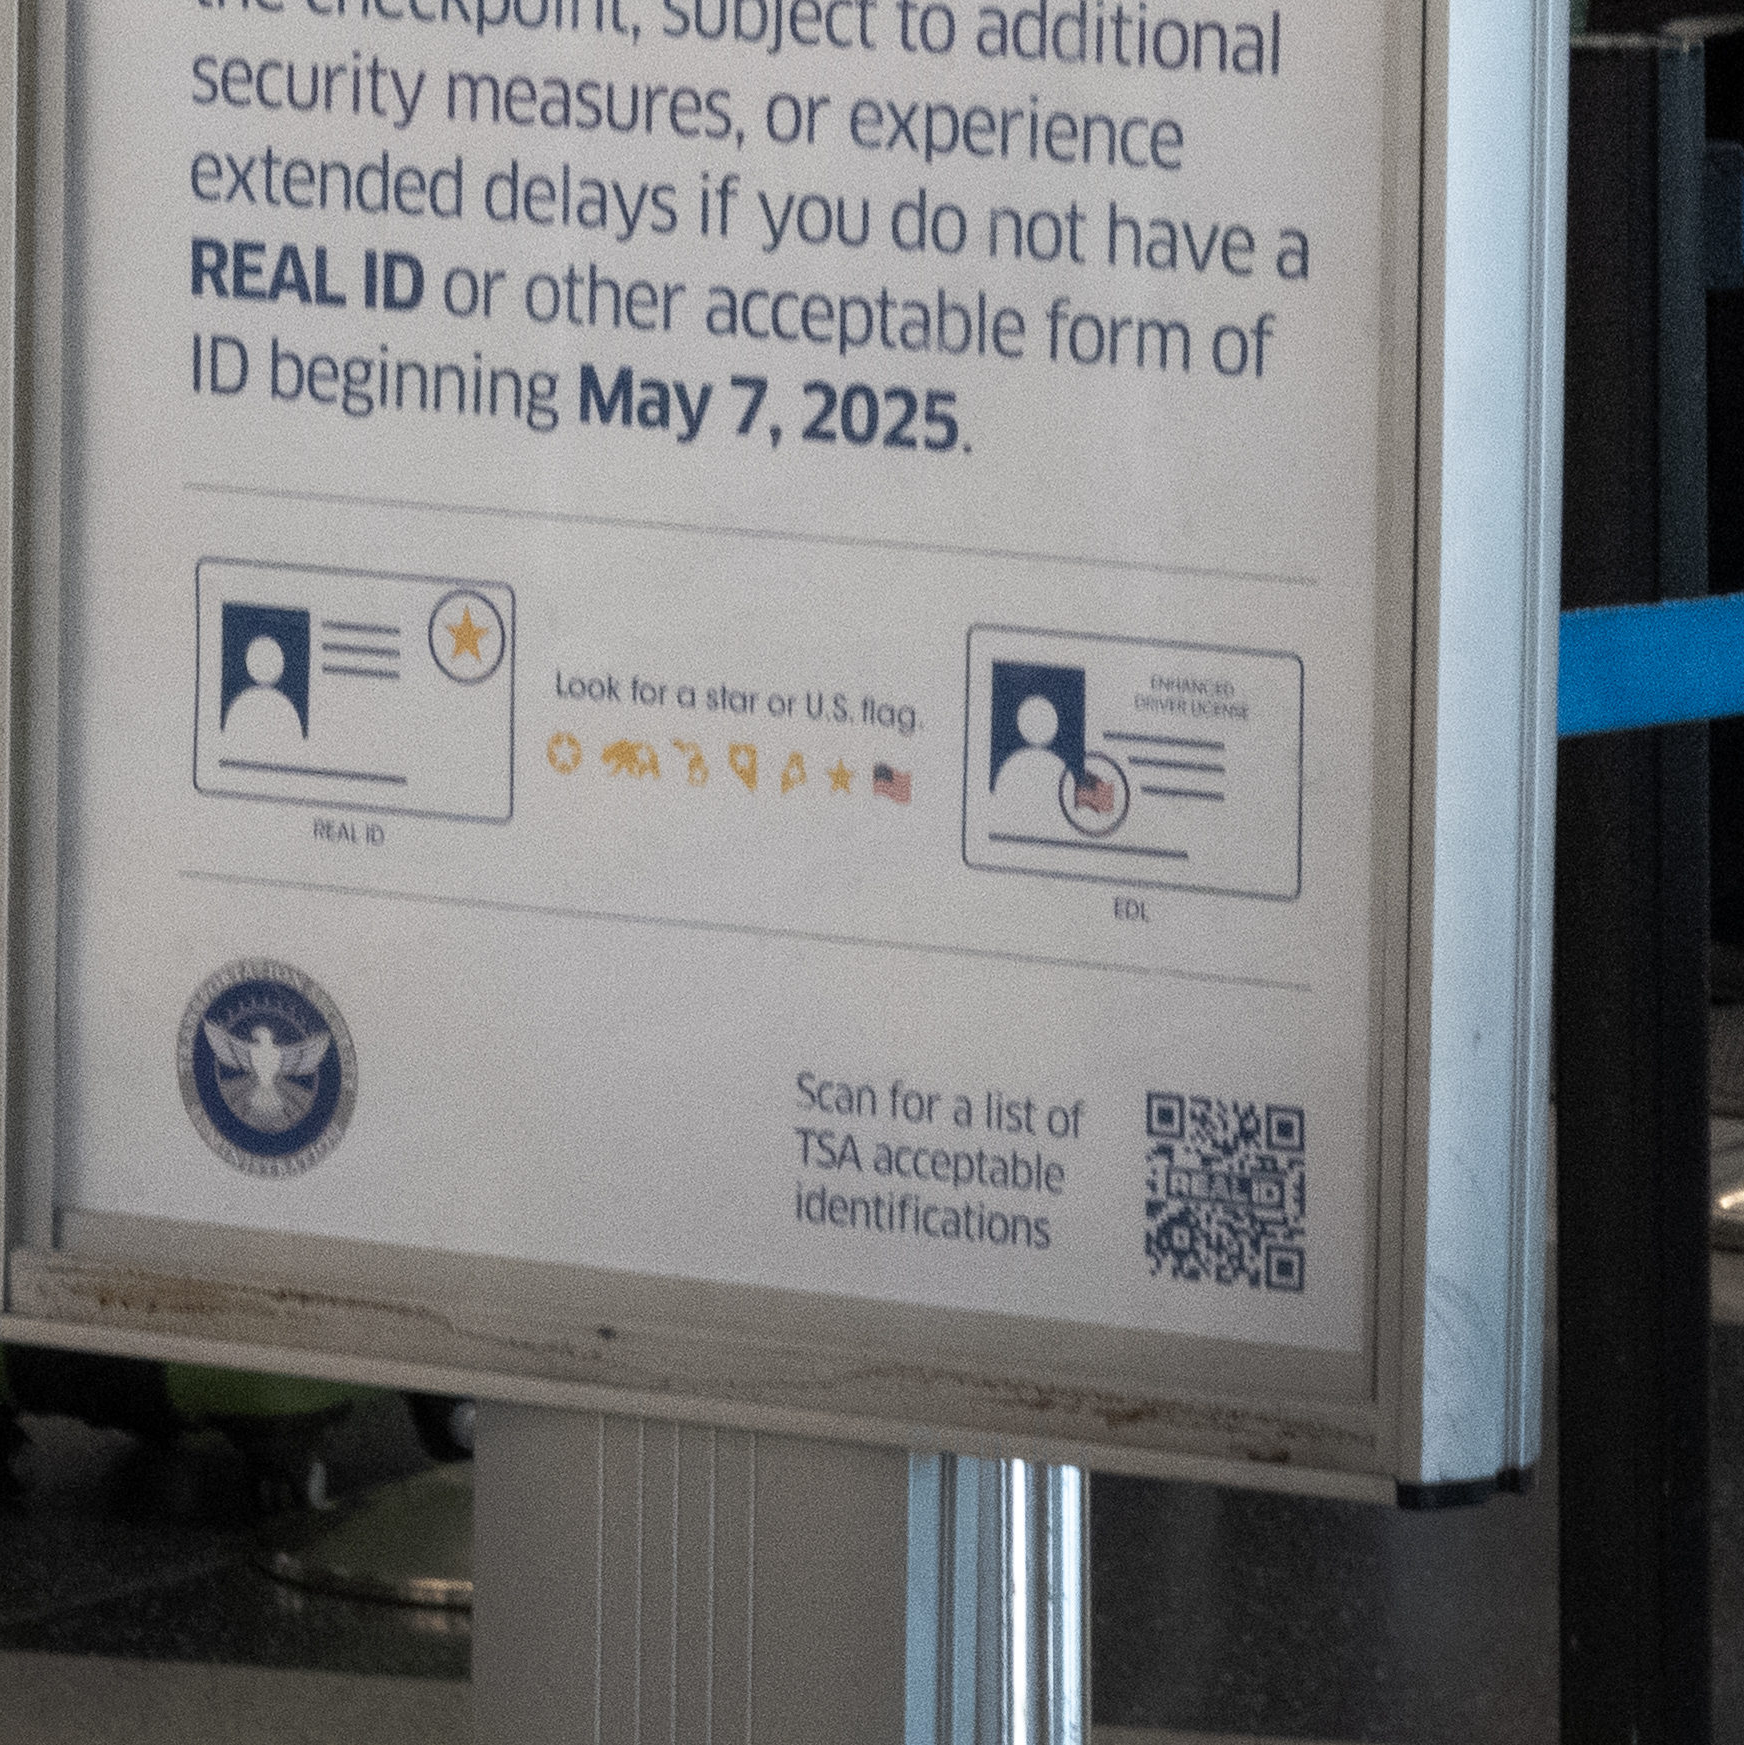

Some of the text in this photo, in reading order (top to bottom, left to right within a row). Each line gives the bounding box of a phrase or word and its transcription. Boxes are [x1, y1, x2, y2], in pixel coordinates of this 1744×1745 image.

[191, 49, 1185, 173] security measures, or experience
[189, 145, 1311, 282] extended delays if you do not have a
[190, 235, 1277, 379] REAL ID or other acceptable form of
[191, 332, 973, 455] ID beginning May 7, 2025.
[555, 670, 924, 737] Look for a star or U.S. flag.
[313, 818, 385, 846] REAL ID
[1115, 896, 1150, 923] EDL
[797, 1071, 1084, 1138] Scan for a list of
[795, 1127, 1066, 1196] TSA acceptable
[796, 1182, 1051, 1250] identifications
